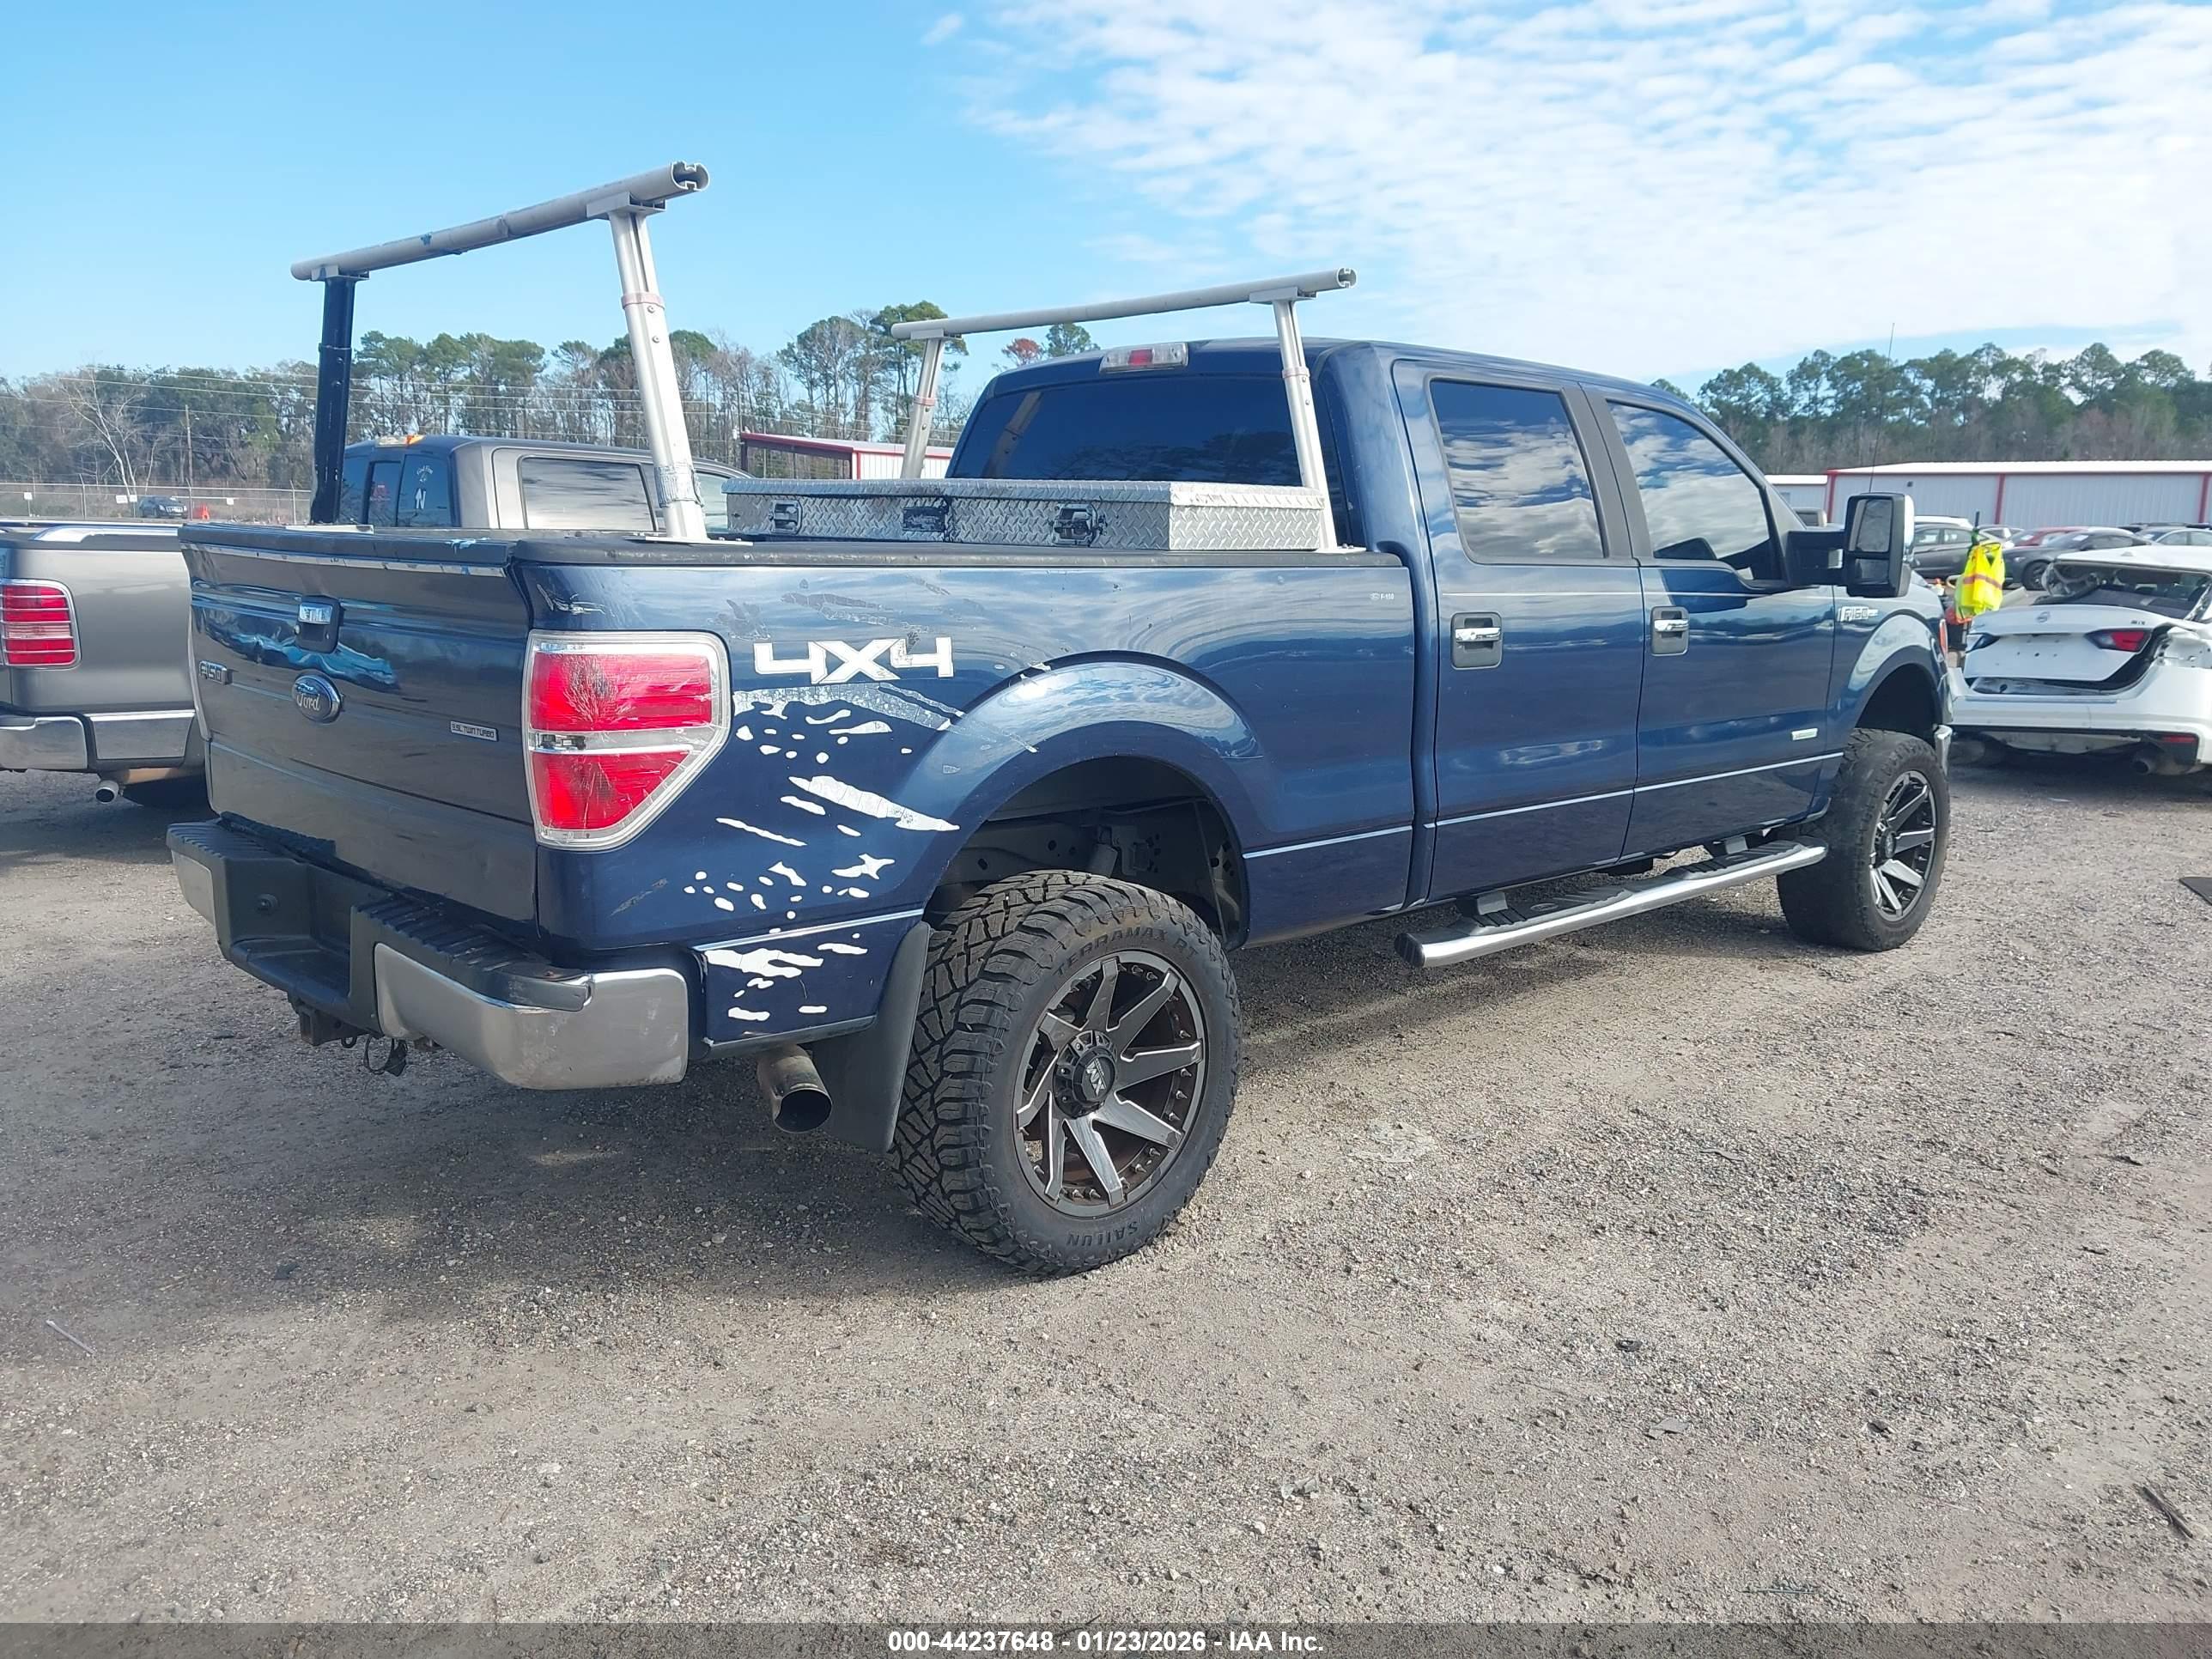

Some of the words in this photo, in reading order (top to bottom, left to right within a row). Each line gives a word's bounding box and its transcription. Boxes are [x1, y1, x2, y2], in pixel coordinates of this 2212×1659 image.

[753, 636, 954, 685] 4X4
[296, 692, 321, 711] Ford
[1052, 927, 1168, 976] TERRAMAX
[1066, 1220, 1138, 1247] SAILUN
